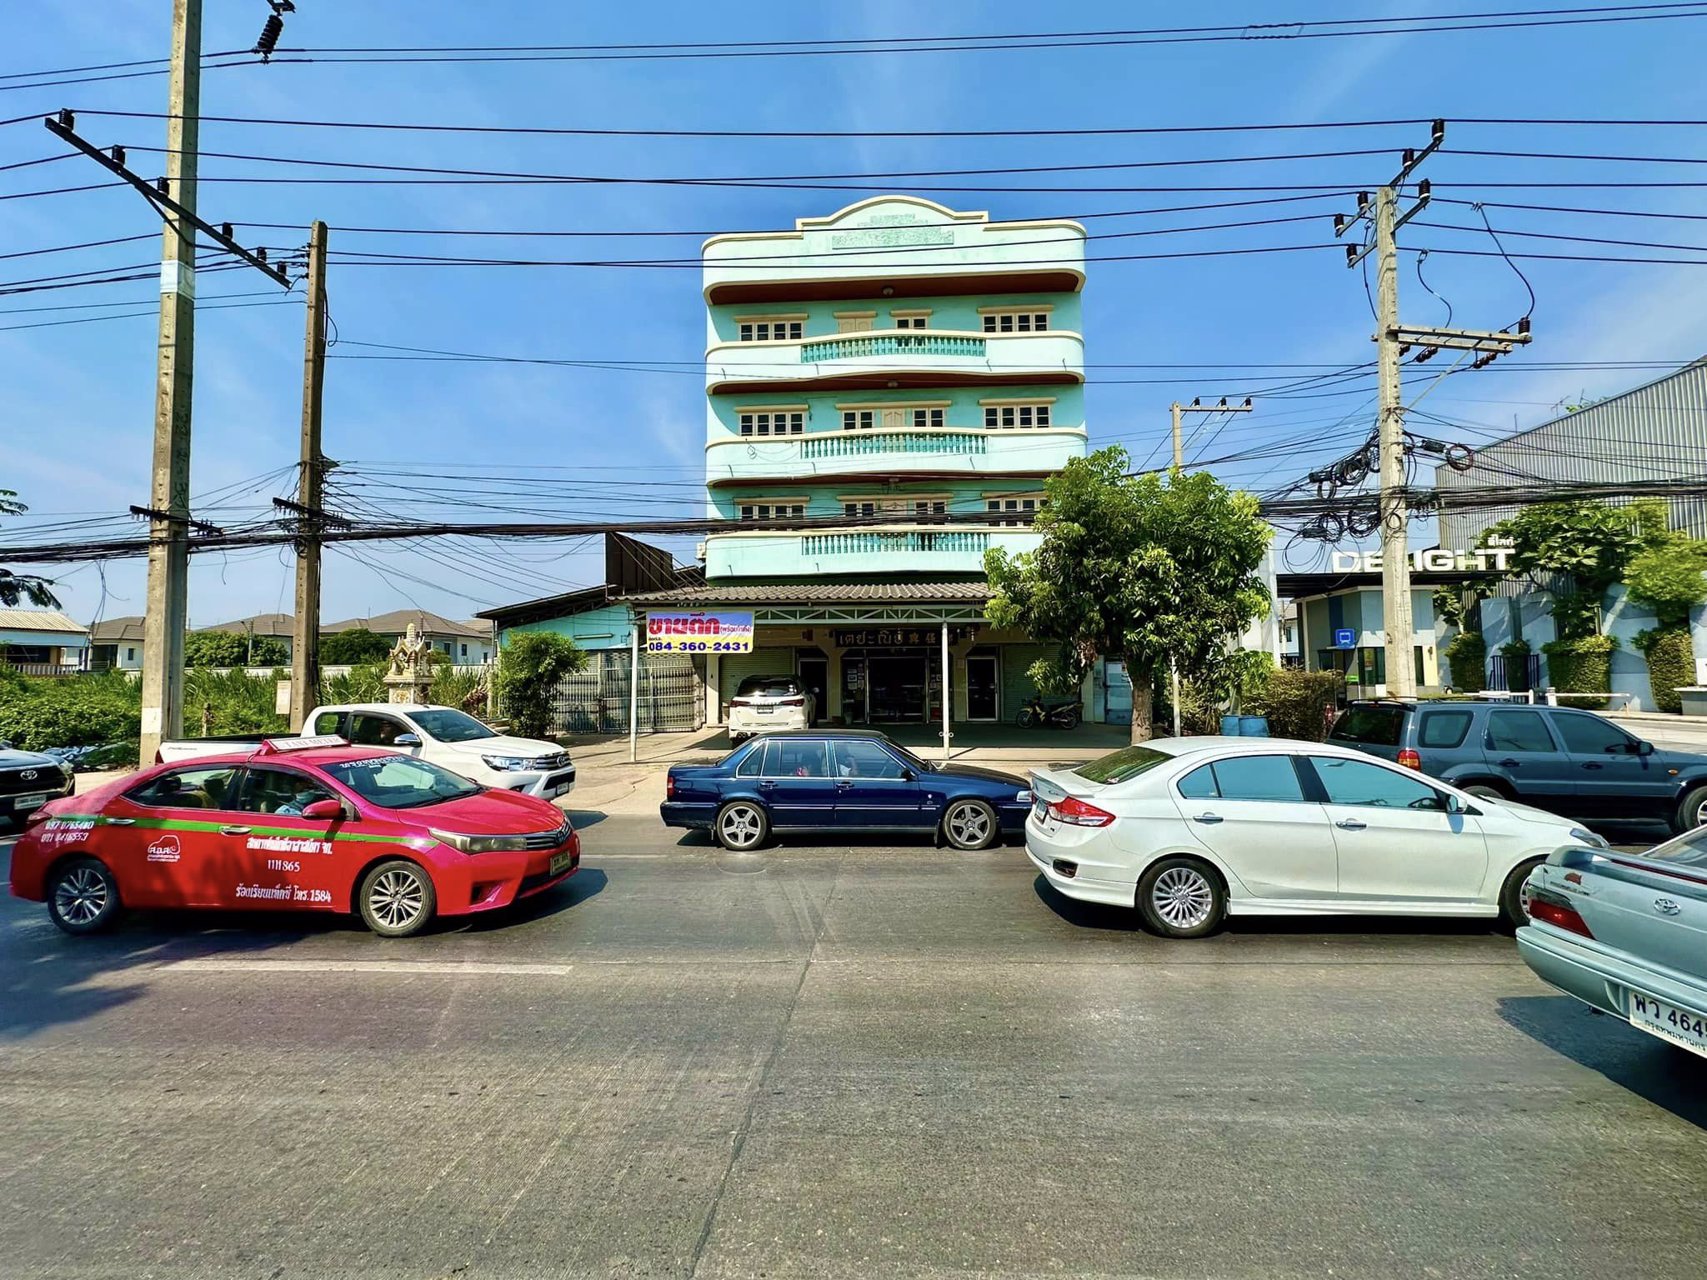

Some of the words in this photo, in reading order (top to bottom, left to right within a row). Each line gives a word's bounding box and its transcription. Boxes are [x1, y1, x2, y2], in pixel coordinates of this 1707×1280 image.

[1332, 548, 1516, 573] DEIGHT
[649, 612, 720, 635] ขายตึก
[648, 642, 749, 651] 084-360-2431
[1668, 1009, 1707, 1038] 464
